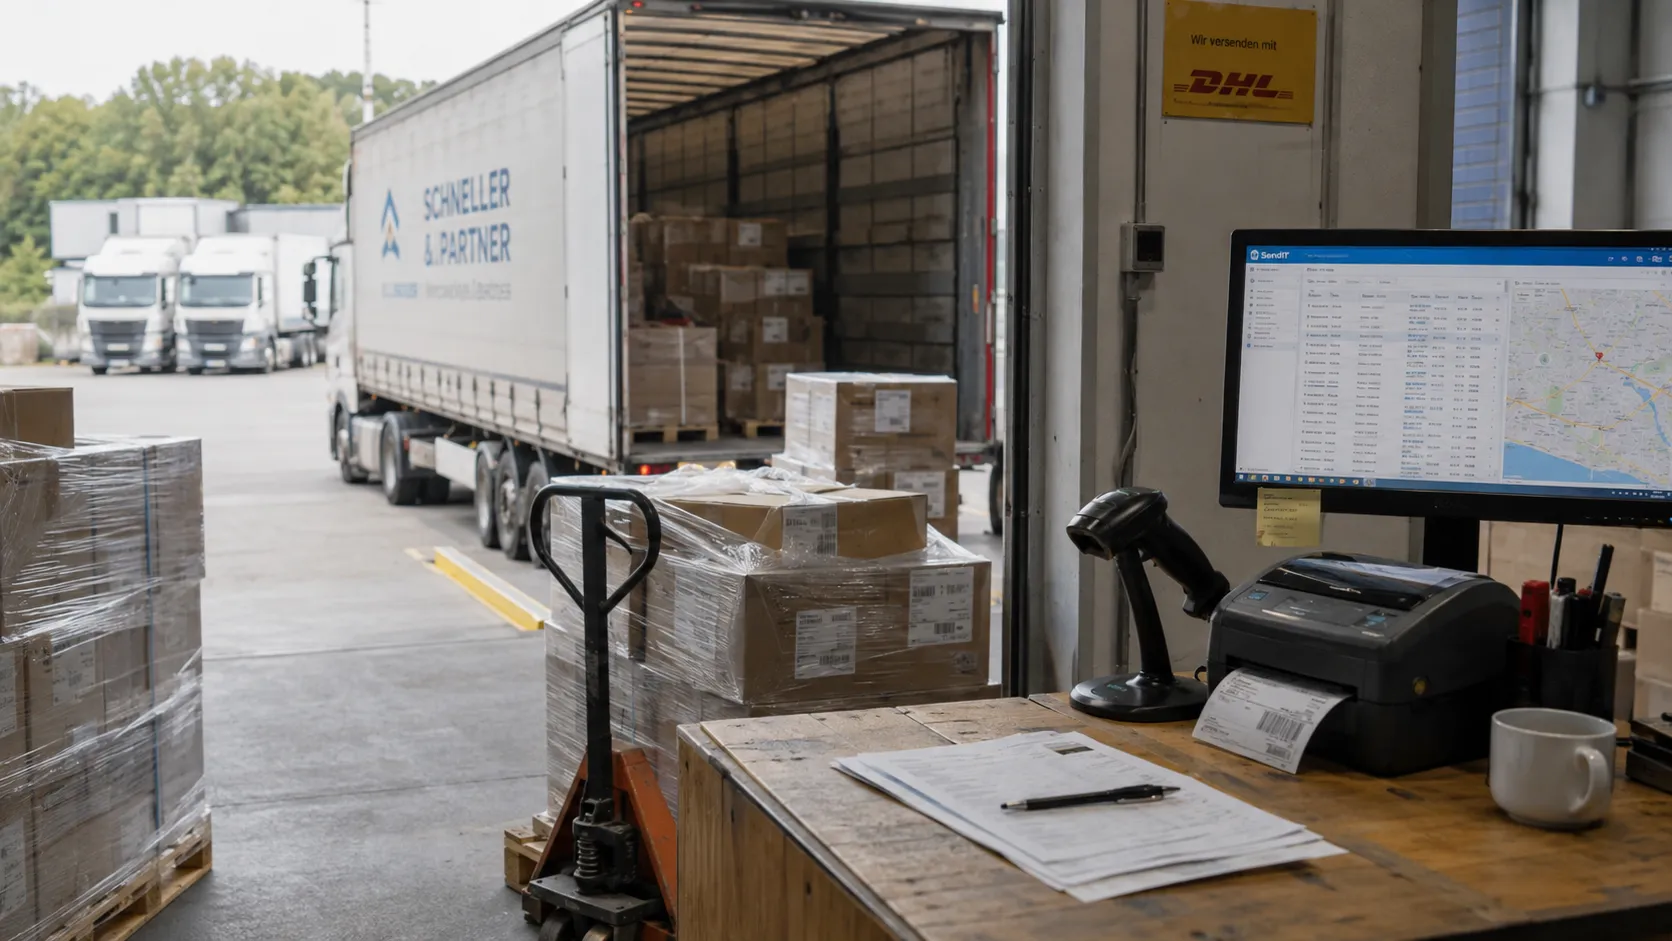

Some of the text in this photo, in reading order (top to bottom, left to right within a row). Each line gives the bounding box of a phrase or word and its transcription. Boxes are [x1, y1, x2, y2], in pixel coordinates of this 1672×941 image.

[1191, 34, 1277, 51] Wir versenden mit
[1189, 69, 1279, 98] DHL
[424, 168, 511, 221] SCHNELLER
[440, 222, 511, 266] PARTNER
